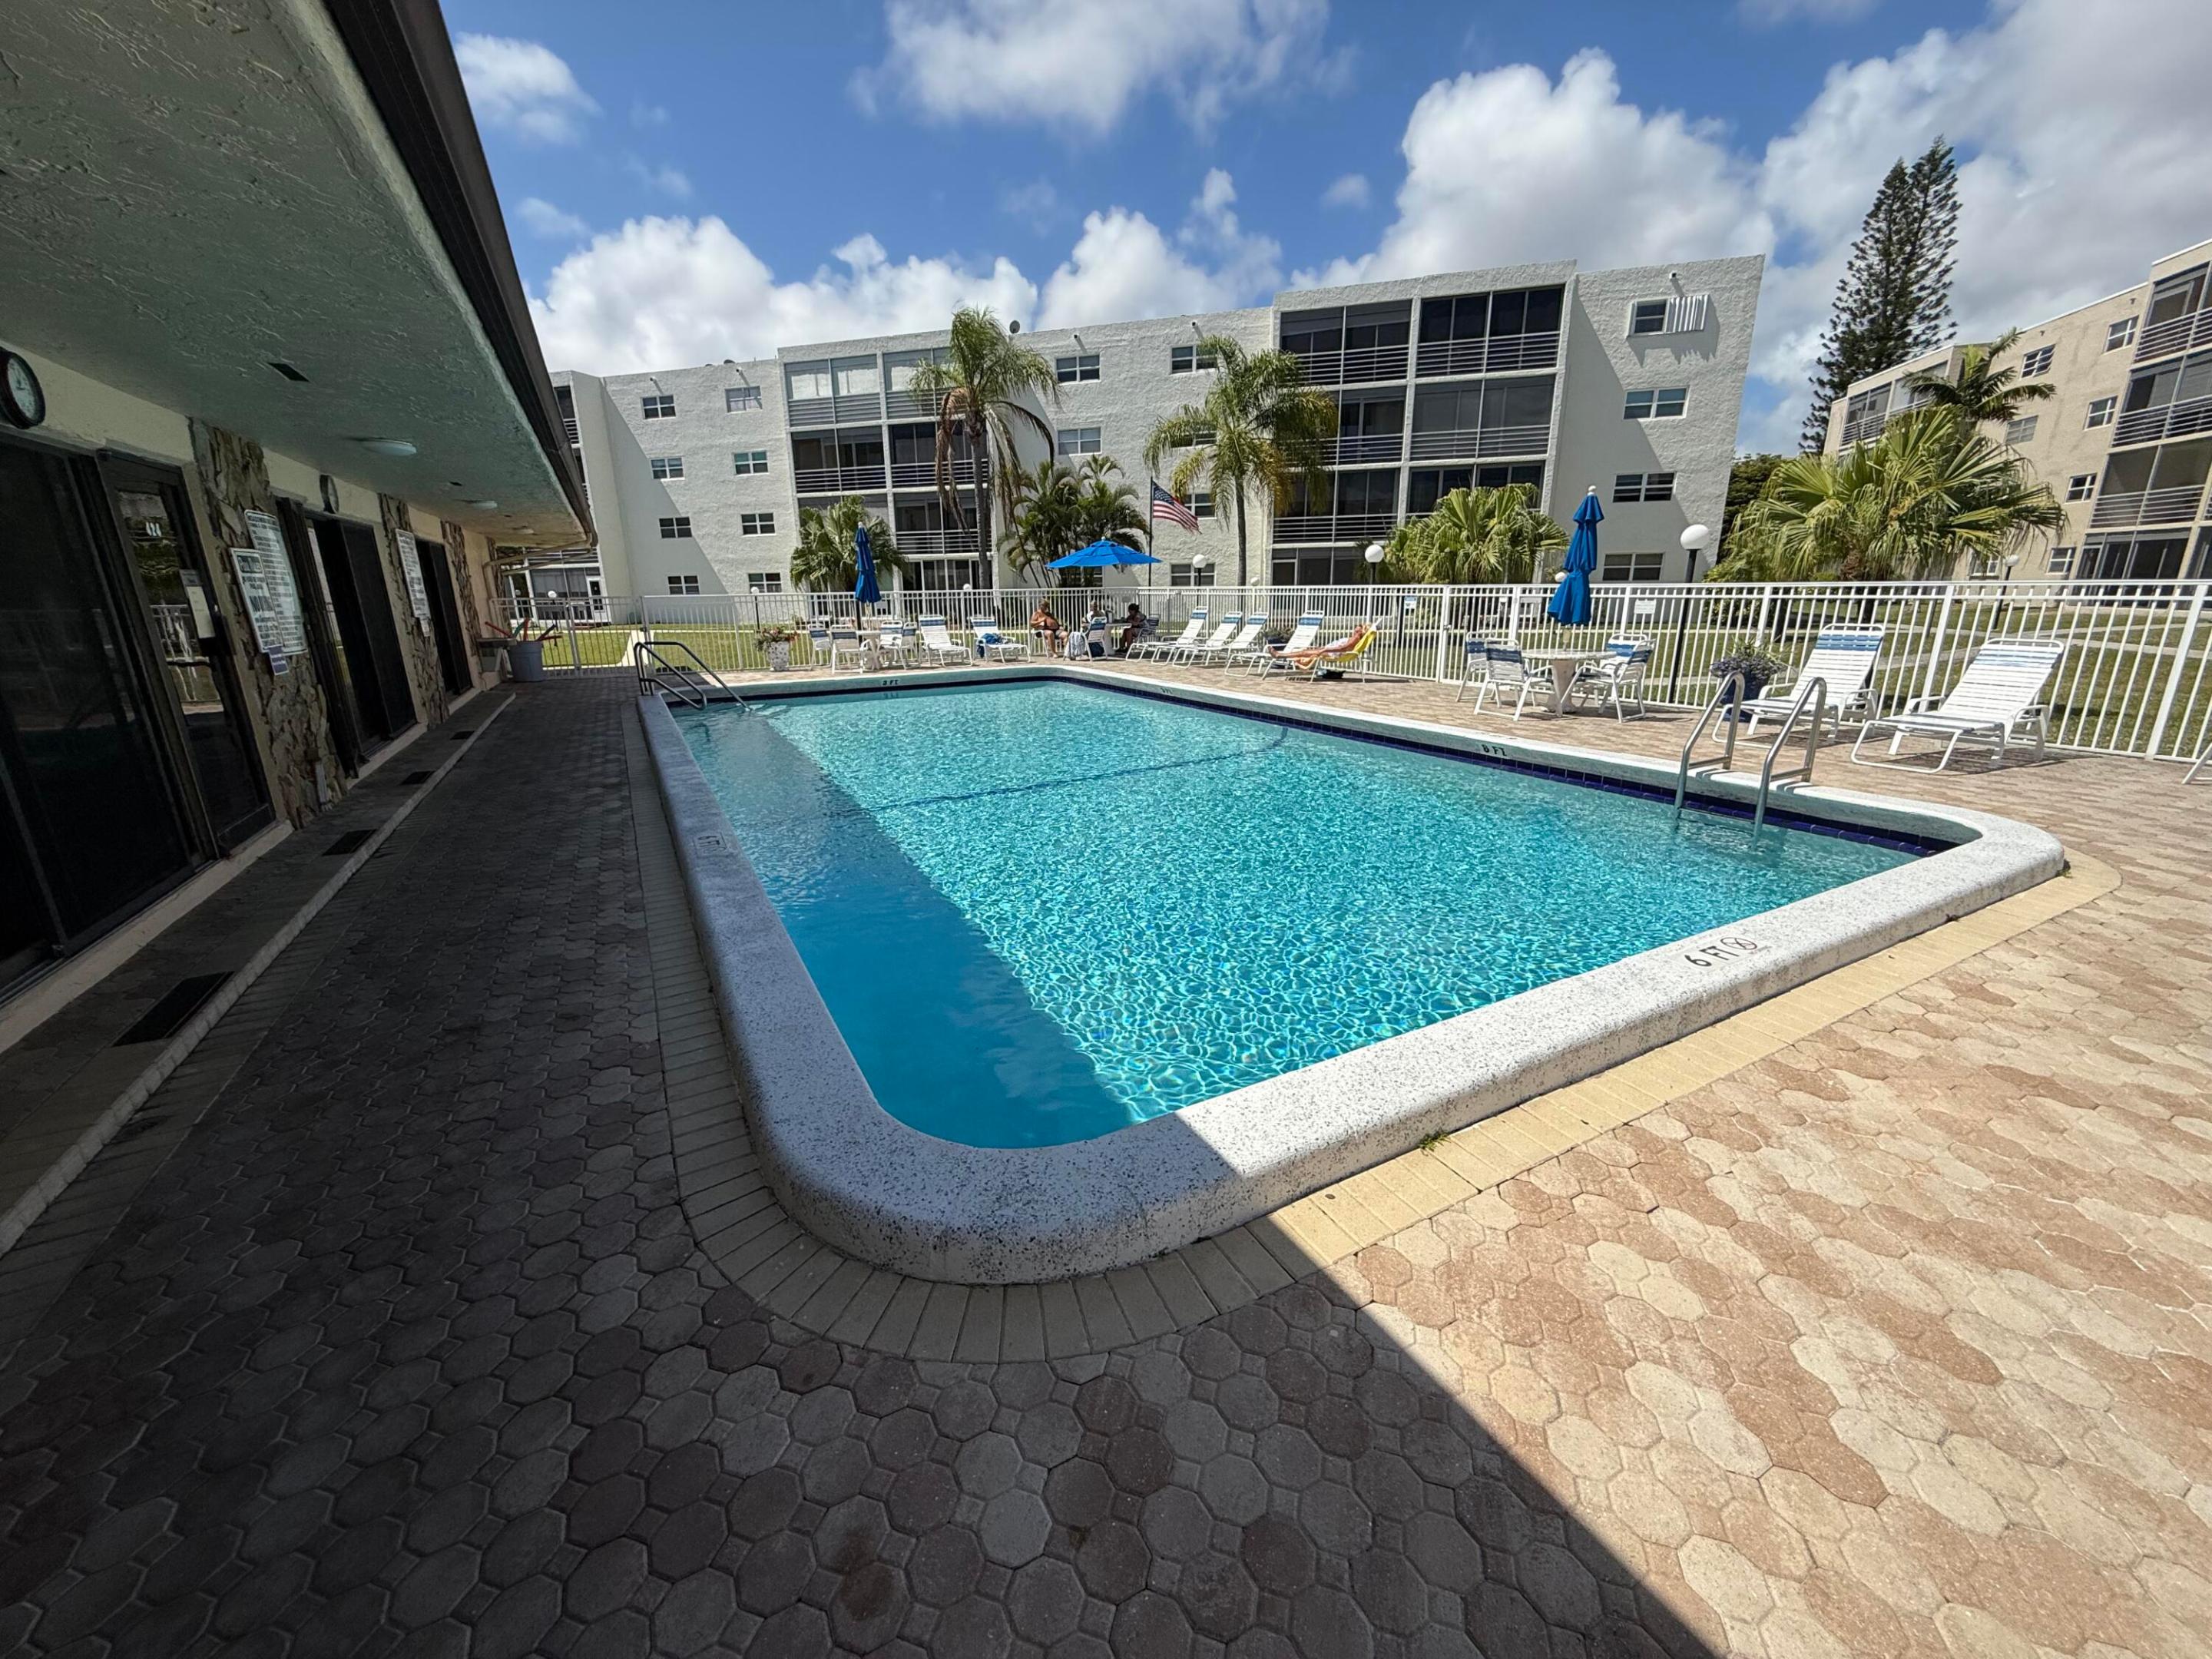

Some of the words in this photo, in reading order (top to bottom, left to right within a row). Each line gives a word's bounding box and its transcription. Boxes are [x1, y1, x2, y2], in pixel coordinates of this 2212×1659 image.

[1492, 746, 1507, 757] FT
[1684, 955, 1713, 967] 6
[1700, 945, 1740, 961] FT
